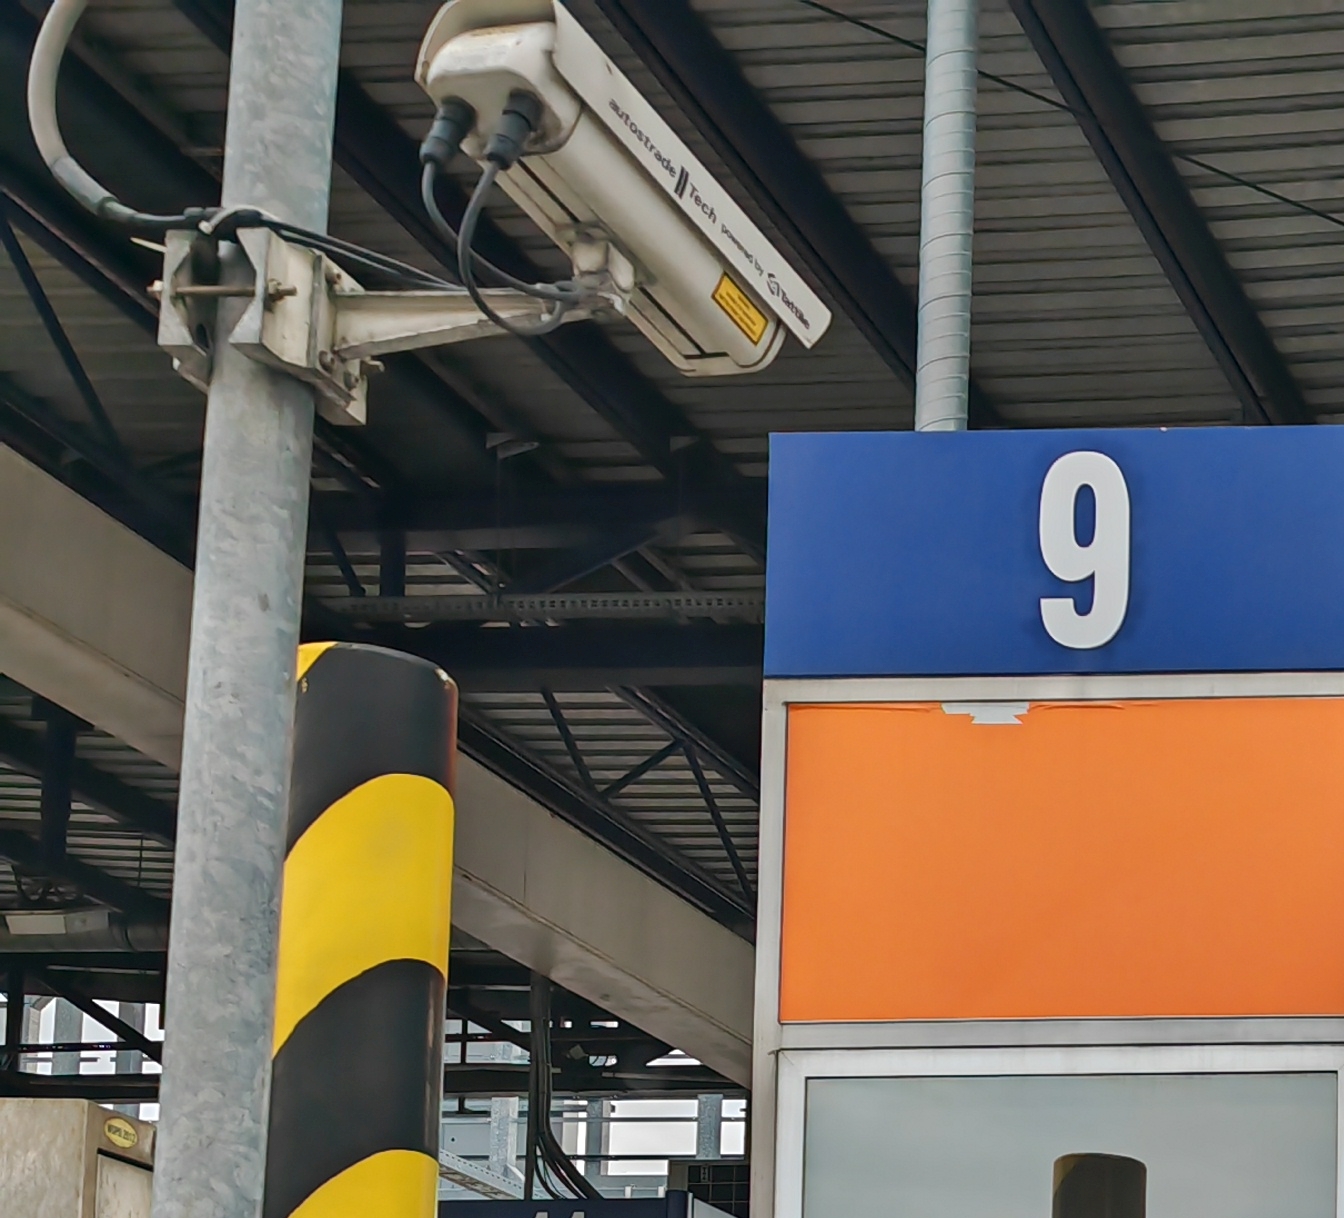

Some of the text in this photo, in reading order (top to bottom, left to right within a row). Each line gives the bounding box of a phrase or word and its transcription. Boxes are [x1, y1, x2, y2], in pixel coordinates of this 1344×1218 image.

[608, 98, 677, 178] autostrade
[689, 182, 717, 224] Tech
[1039, 450, 1130, 649] 9
